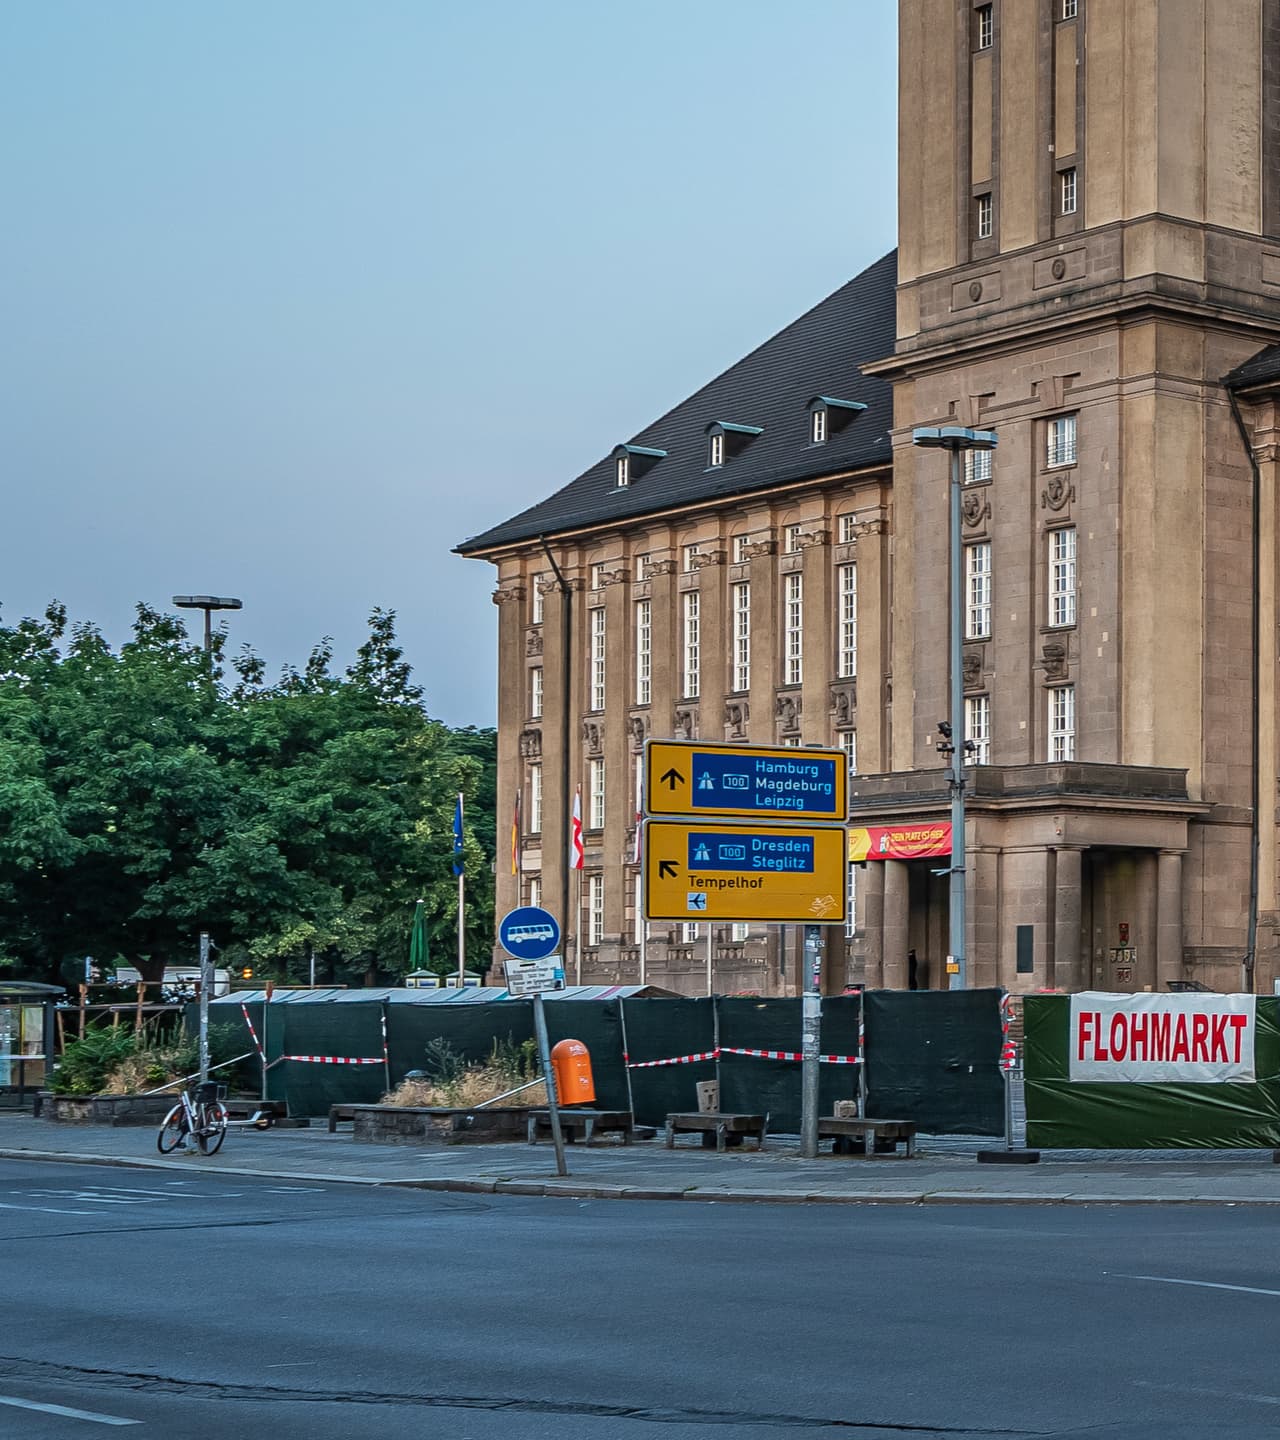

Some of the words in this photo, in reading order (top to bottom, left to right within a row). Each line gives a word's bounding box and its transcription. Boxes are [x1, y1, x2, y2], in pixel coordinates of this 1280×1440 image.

[755, 760, 819, 777] Hamburg
[726, 777, 745, 787] 100
[755, 777, 832, 795] Magdeburg
[755, 793, 804, 810] Leipzig
[724, 847, 741, 857] 100
[752, 839, 810, 853] Dresden
[752, 856, 806, 871] Steglitz
[688, 875, 763, 890] Tempelhof
[1078, 1012, 1247, 1063] FLOHMARKT
